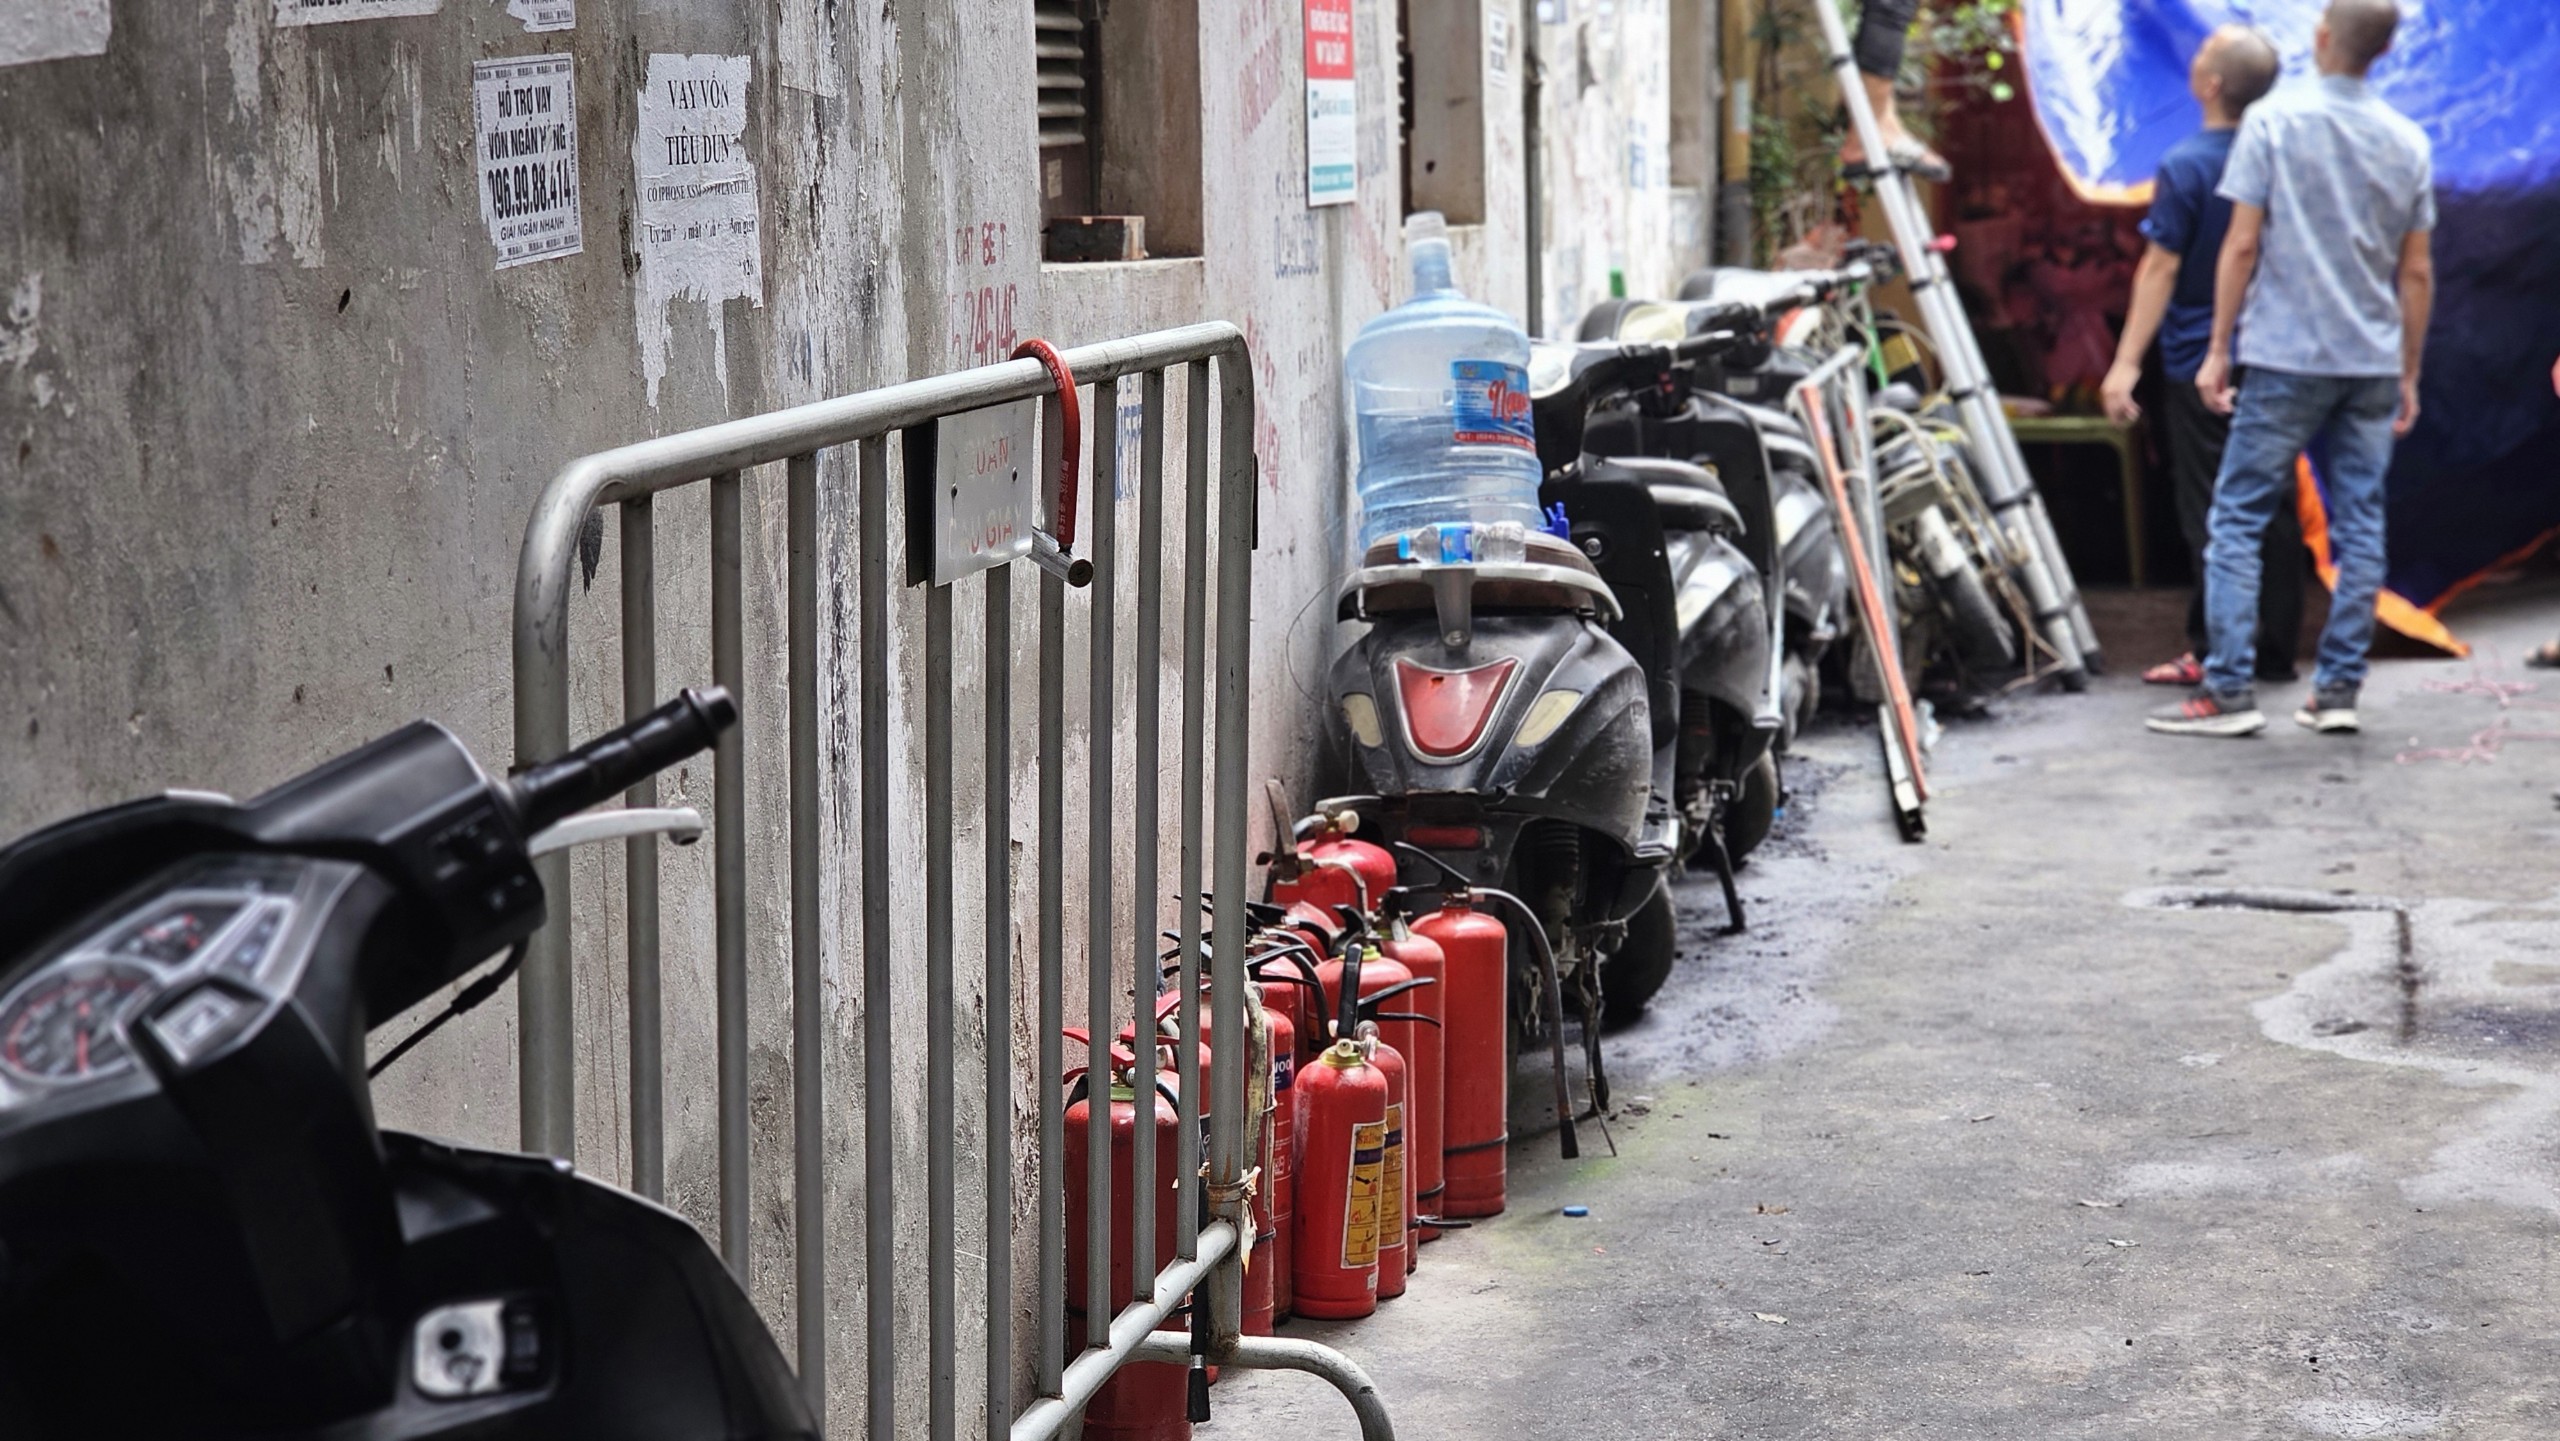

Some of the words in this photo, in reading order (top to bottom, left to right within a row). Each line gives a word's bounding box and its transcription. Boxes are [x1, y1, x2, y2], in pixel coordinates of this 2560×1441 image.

[498, 79, 512, 119] HỖ
[514, 84, 533, 121] TRỢ
[535, 85, 551, 114] VAY
[667, 80, 697, 110] VAY
[488, 121, 509, 161] VỐN
[510, 122, 538, 158] NGÂN
[540, 119, 566, 153] HNG
[665, 125, 700, 165] TIÊU
[517, 219, 538, 237] NGÂN
[539, 216, 565, 233] NHANH
